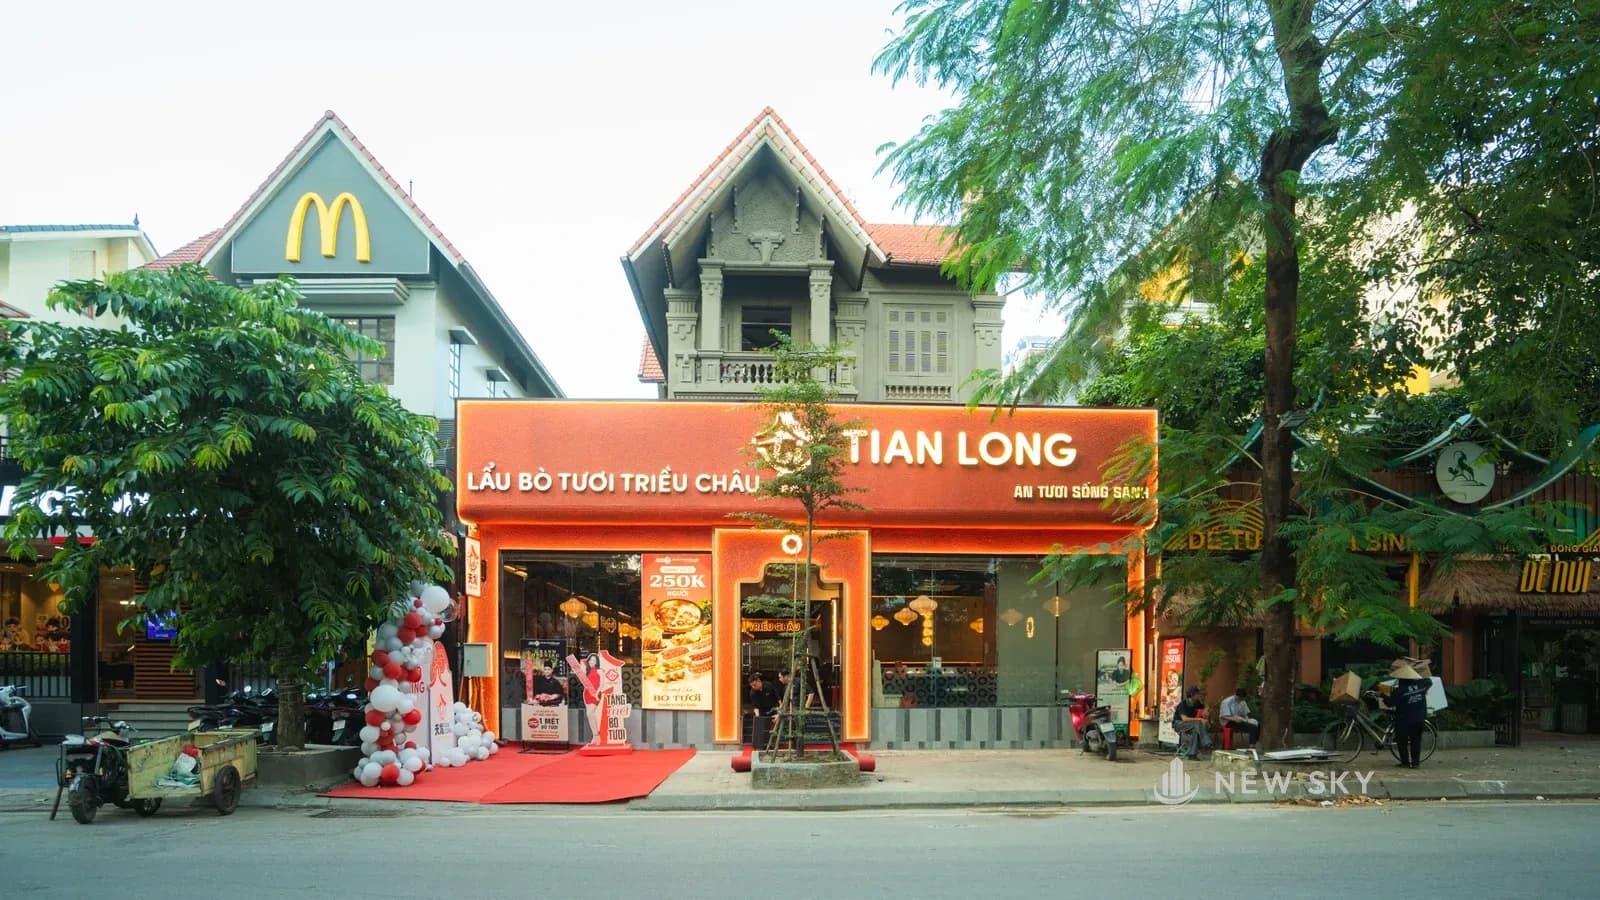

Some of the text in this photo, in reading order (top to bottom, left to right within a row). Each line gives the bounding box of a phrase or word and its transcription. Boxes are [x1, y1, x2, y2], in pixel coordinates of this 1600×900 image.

[843, 429, 1077, 467] TIAN LONG
[467, 461, 761, 493] LẨU BÒ TƯƠI TRIỀU CHÂU
[1037, 484, 1068, 499] TƯƠI
[1071, 481, 1109, 499] SỐNG
[649, 574, 705, 588] 250K
